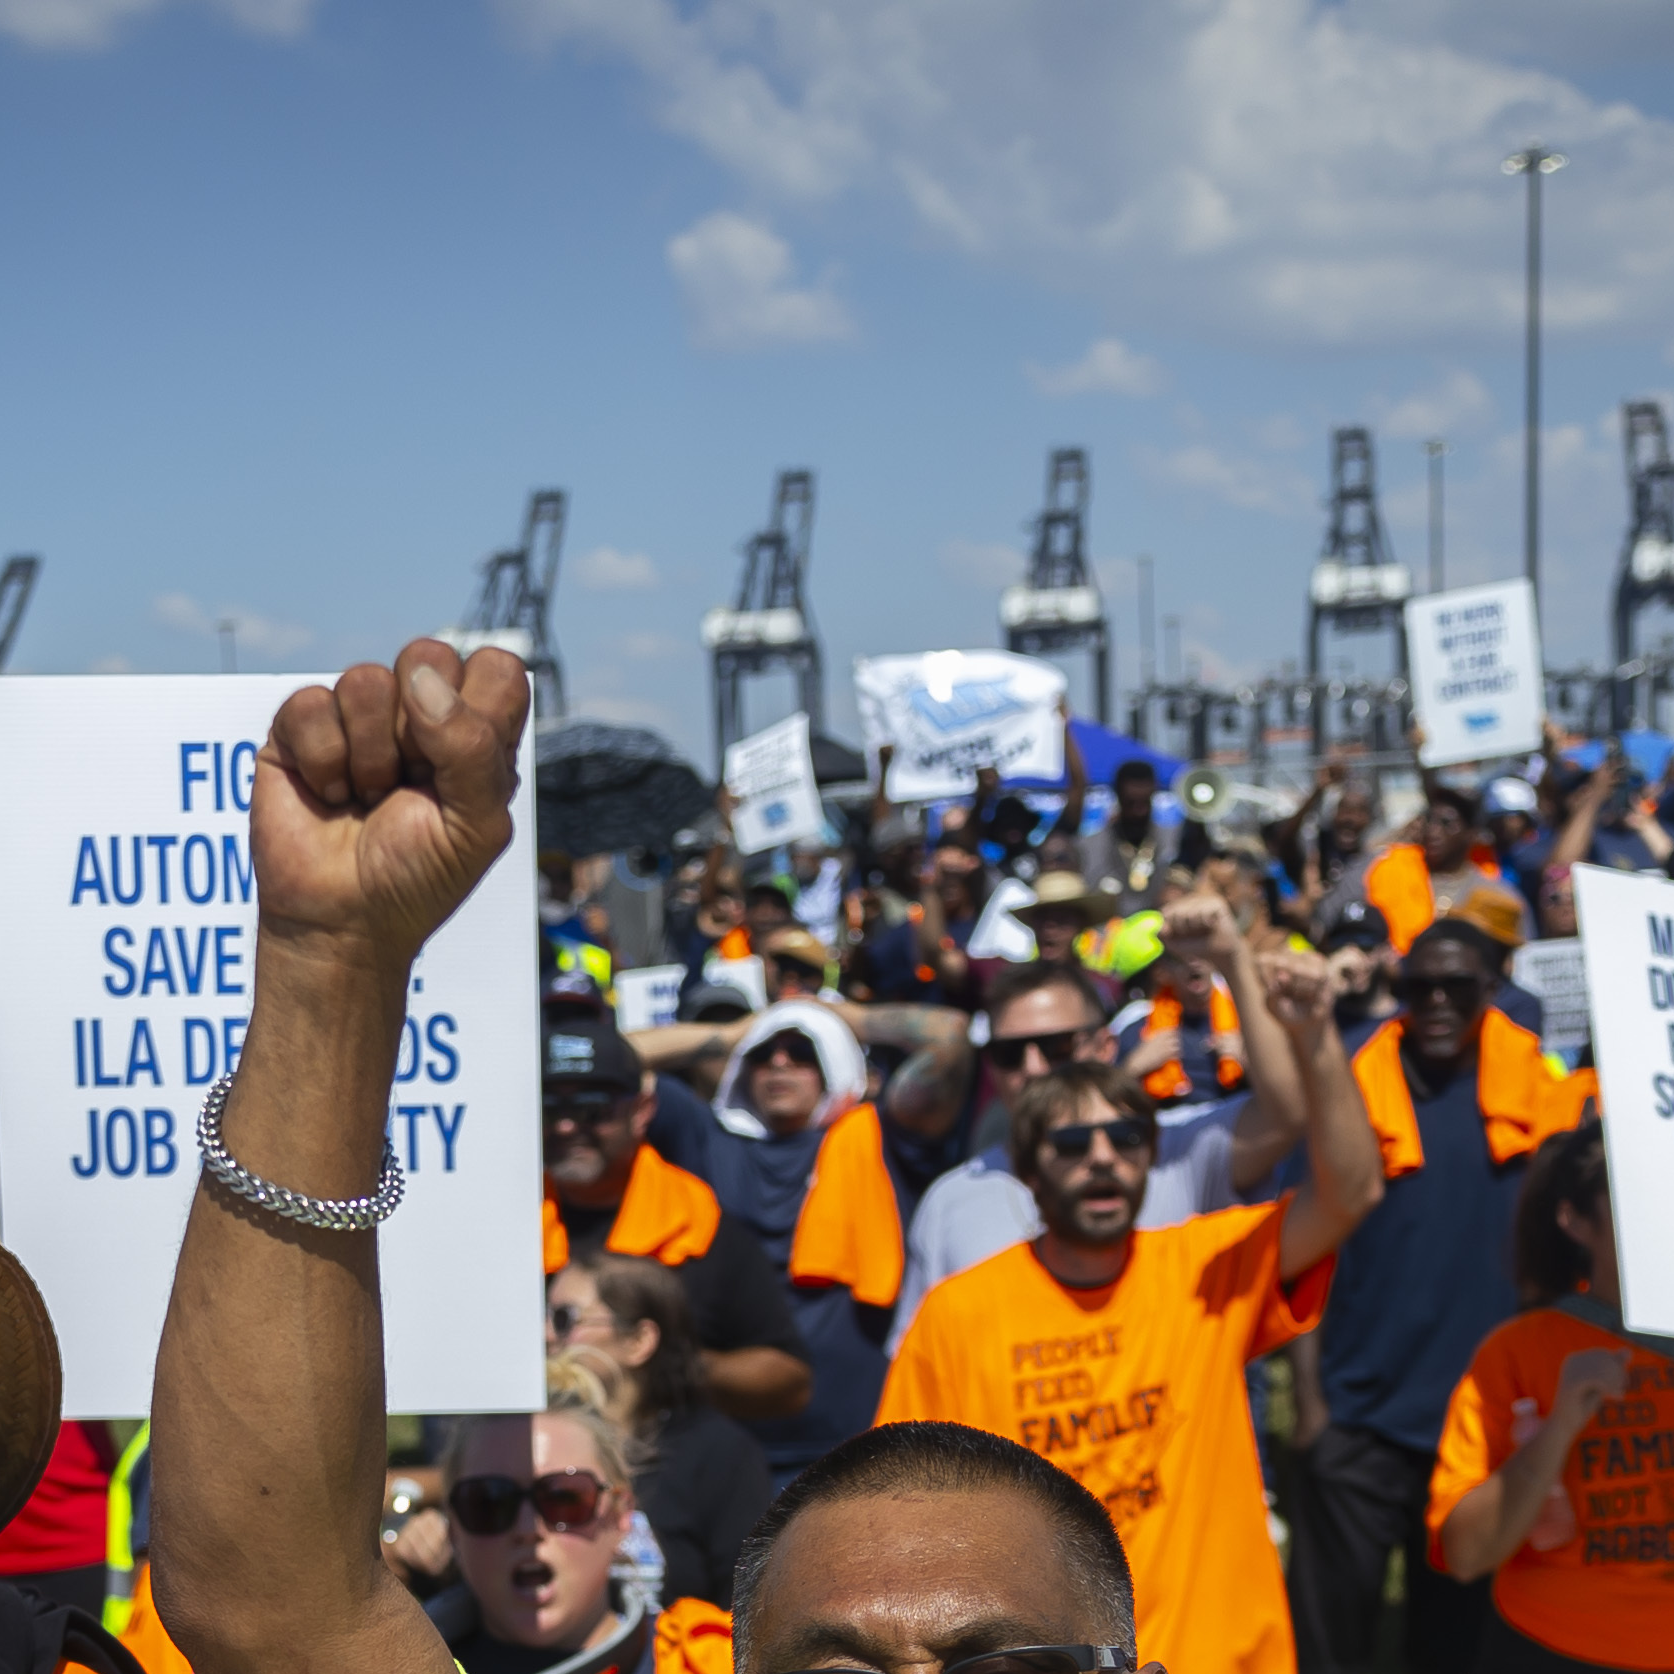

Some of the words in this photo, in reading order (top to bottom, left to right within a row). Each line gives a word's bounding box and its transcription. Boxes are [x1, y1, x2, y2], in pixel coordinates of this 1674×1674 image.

[179, 741, 257, 813] FIG
[71, 834, 254, 907] AUTOM
[102, 925, 245, 998] SAVE
[72, 1017, 164, 1089] ILA
[184, 1013, 461, 1087] DEDS
[70, 1107, 179, 1179] JOB
[1598, 1400, 1658, 1428] EED
